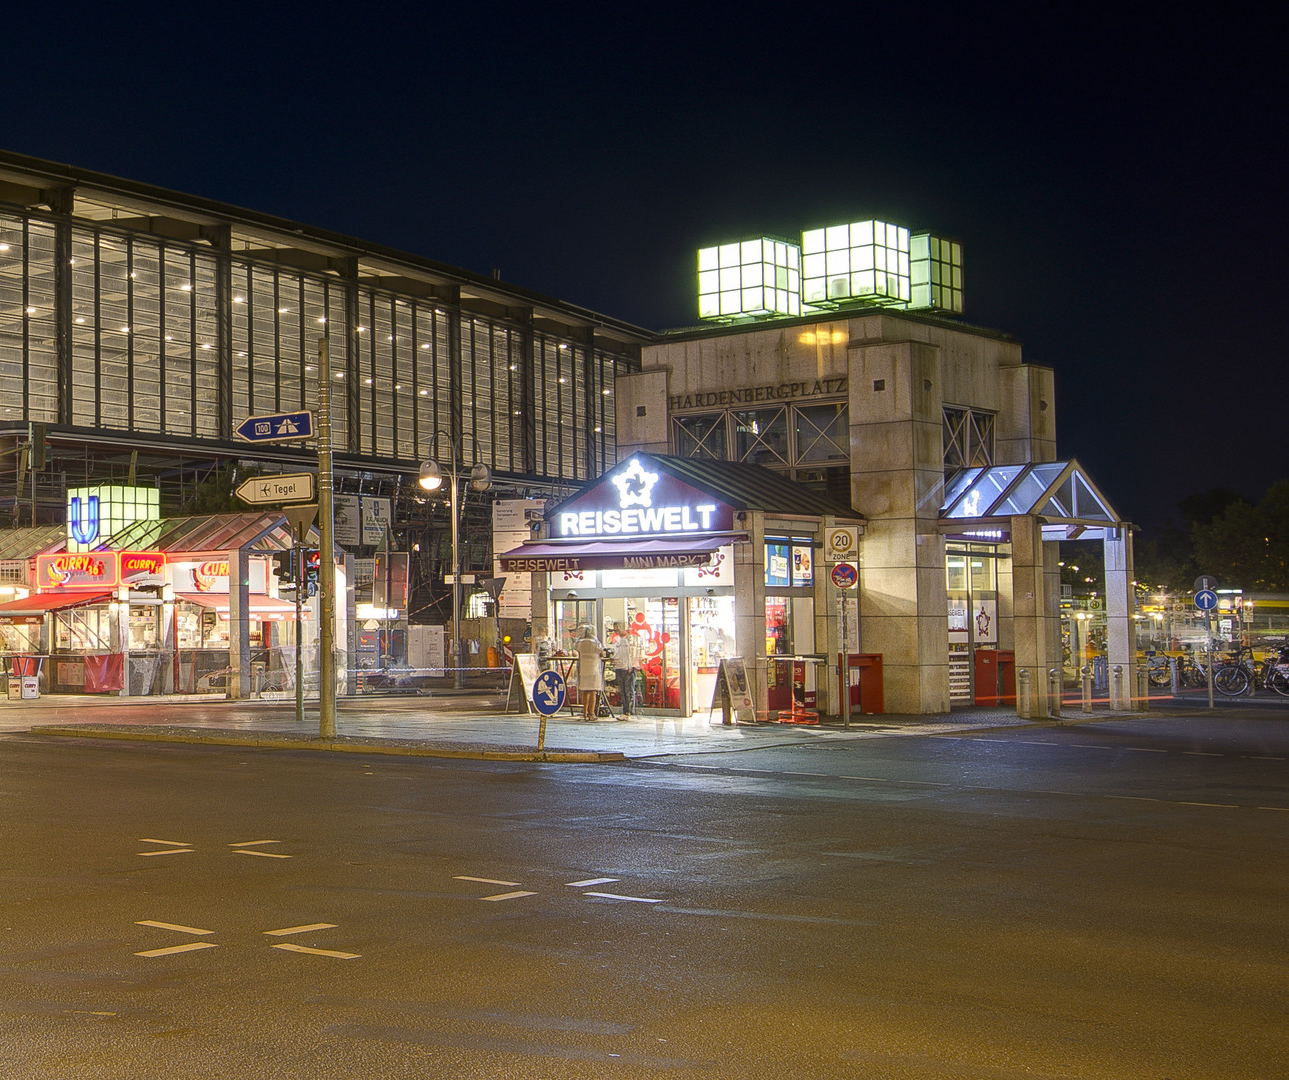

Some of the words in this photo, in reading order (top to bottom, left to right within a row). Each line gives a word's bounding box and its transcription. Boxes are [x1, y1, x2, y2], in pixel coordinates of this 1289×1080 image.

[668, 377, 847, 411] HARDENBERGPLATZ
[257, 423, 269, 434] 100
[274, 483, 296, 496] Tegel
[71, 495, 99, 545] U
[560, 504, 716, 536] REISEWELT
[835, 535, 848, 547] 20
[55, 556, 90, 571] CURRY
[88, 565, 99, 576] 36
[128, 558, 156, 571] CURRY
[507, 558, 580, 572] REISEWELT
[623, 557, 653, 569] MINI
[657, 555, 706, 568] MARKT
